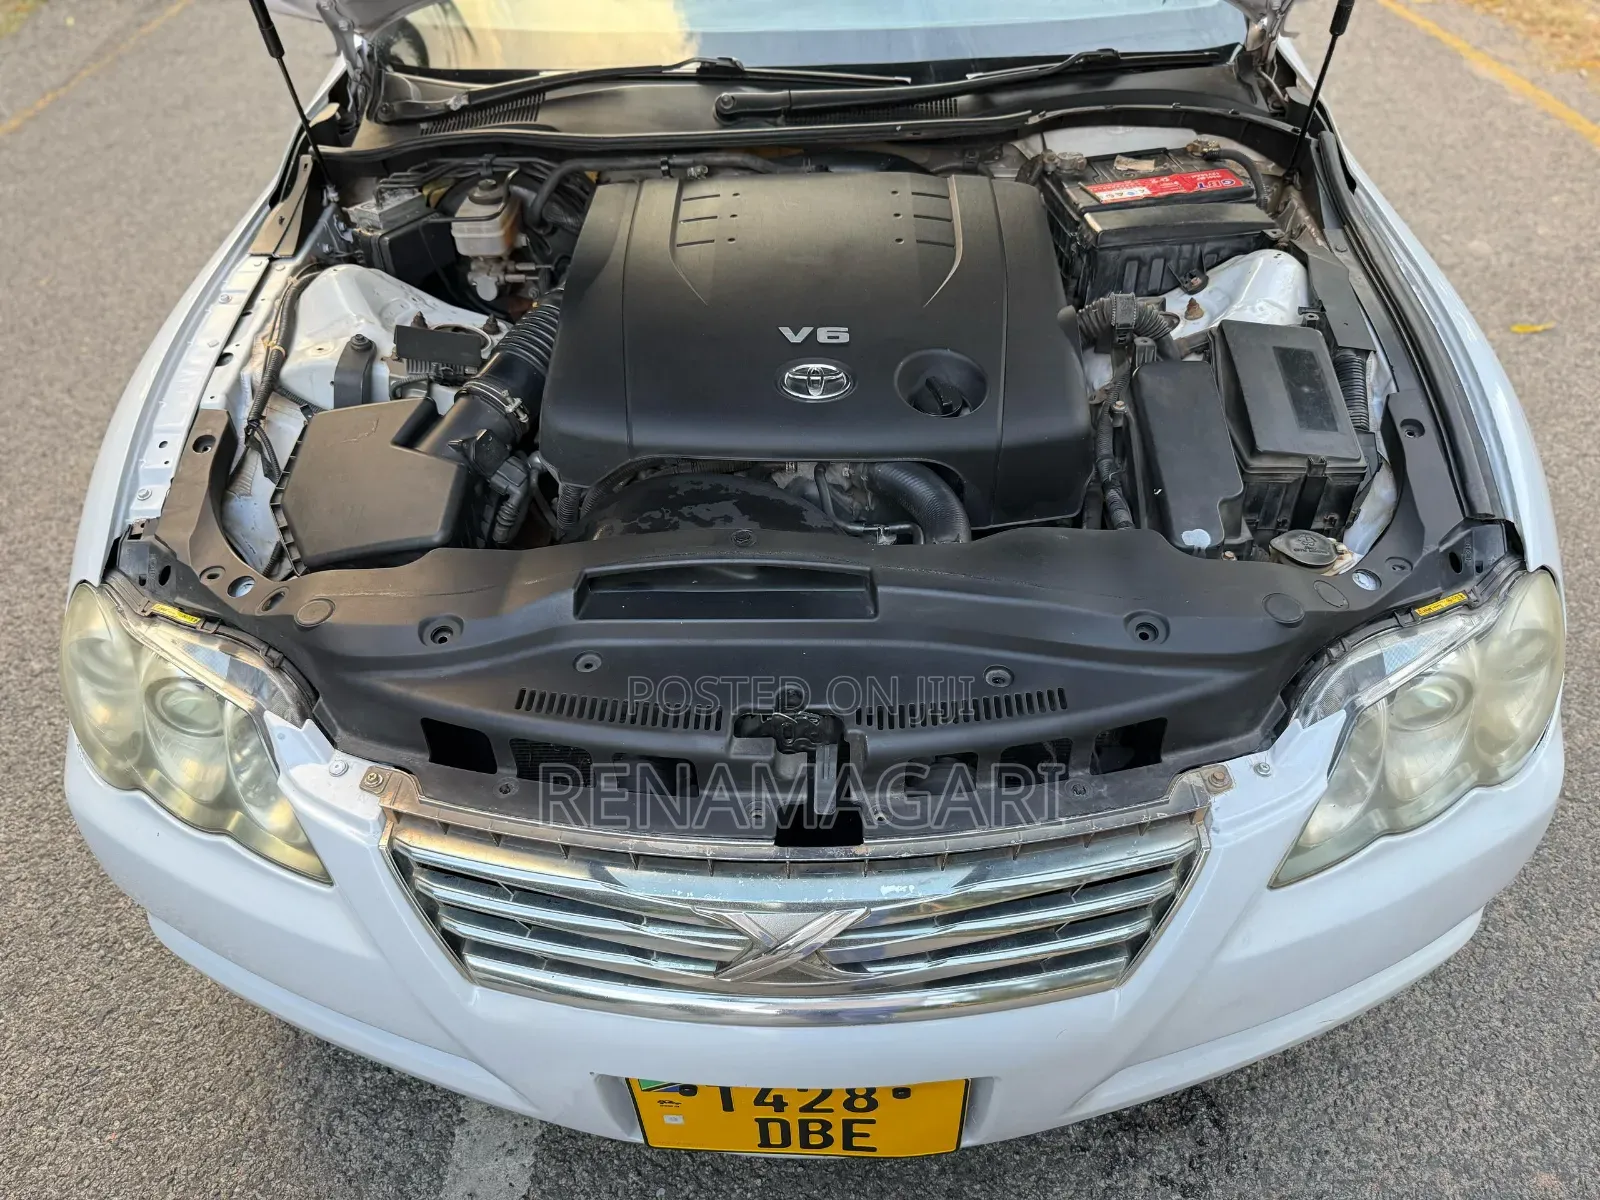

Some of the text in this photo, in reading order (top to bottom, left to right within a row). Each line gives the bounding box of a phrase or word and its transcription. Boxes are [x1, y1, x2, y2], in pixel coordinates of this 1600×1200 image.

[777, 326, 850, 344] V6
[753, 1086, 880, 1114] 428
[753, 1117, 878, 1153] DBE
